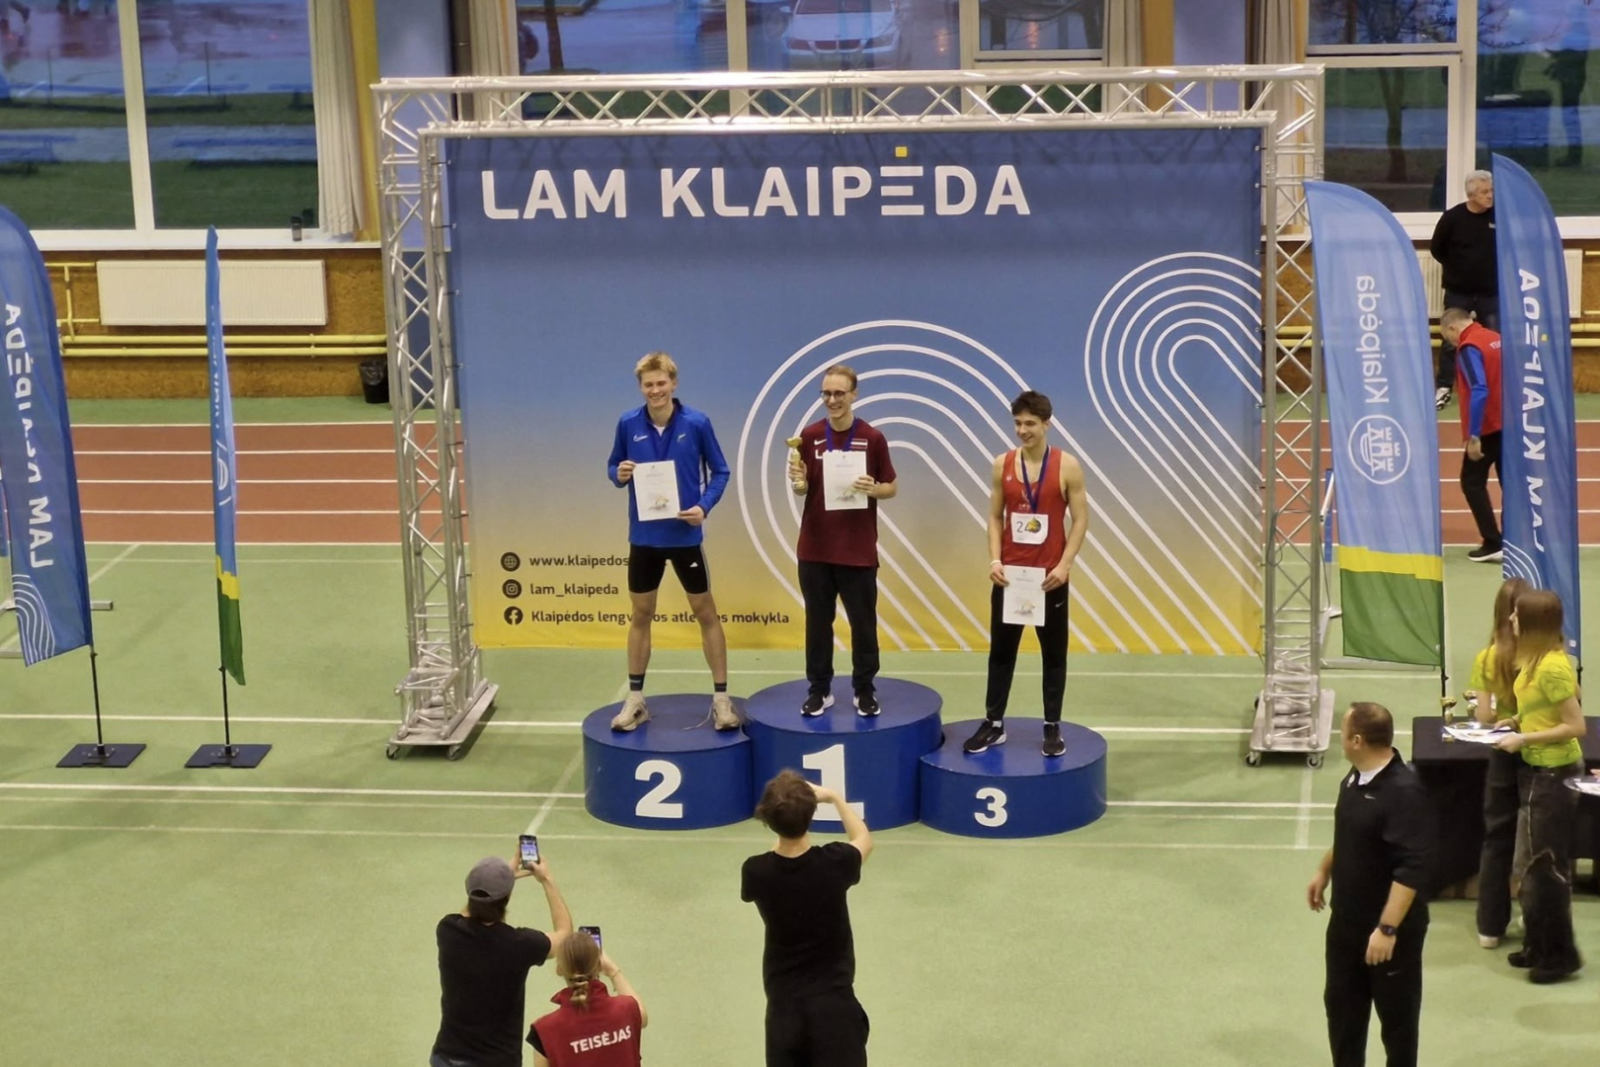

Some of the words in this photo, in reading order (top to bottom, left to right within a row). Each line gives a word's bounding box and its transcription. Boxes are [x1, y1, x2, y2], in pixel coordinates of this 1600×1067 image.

[481, 169, 627, 219] LAM
[660, 146, 1031, 217] KLAIPĖDA
[530, 583, 619, 598] lam_klaipeda
[531, 610, 594, 625] Klaipėdos
[732, 611, 789, 626] mokykla
[634, 760, 683, 819] 2
[802, 744, 865, 822] 1
[974, 787, 1008, 828] 3
[569, 1025, 632, 1054] TEISĖJAS
